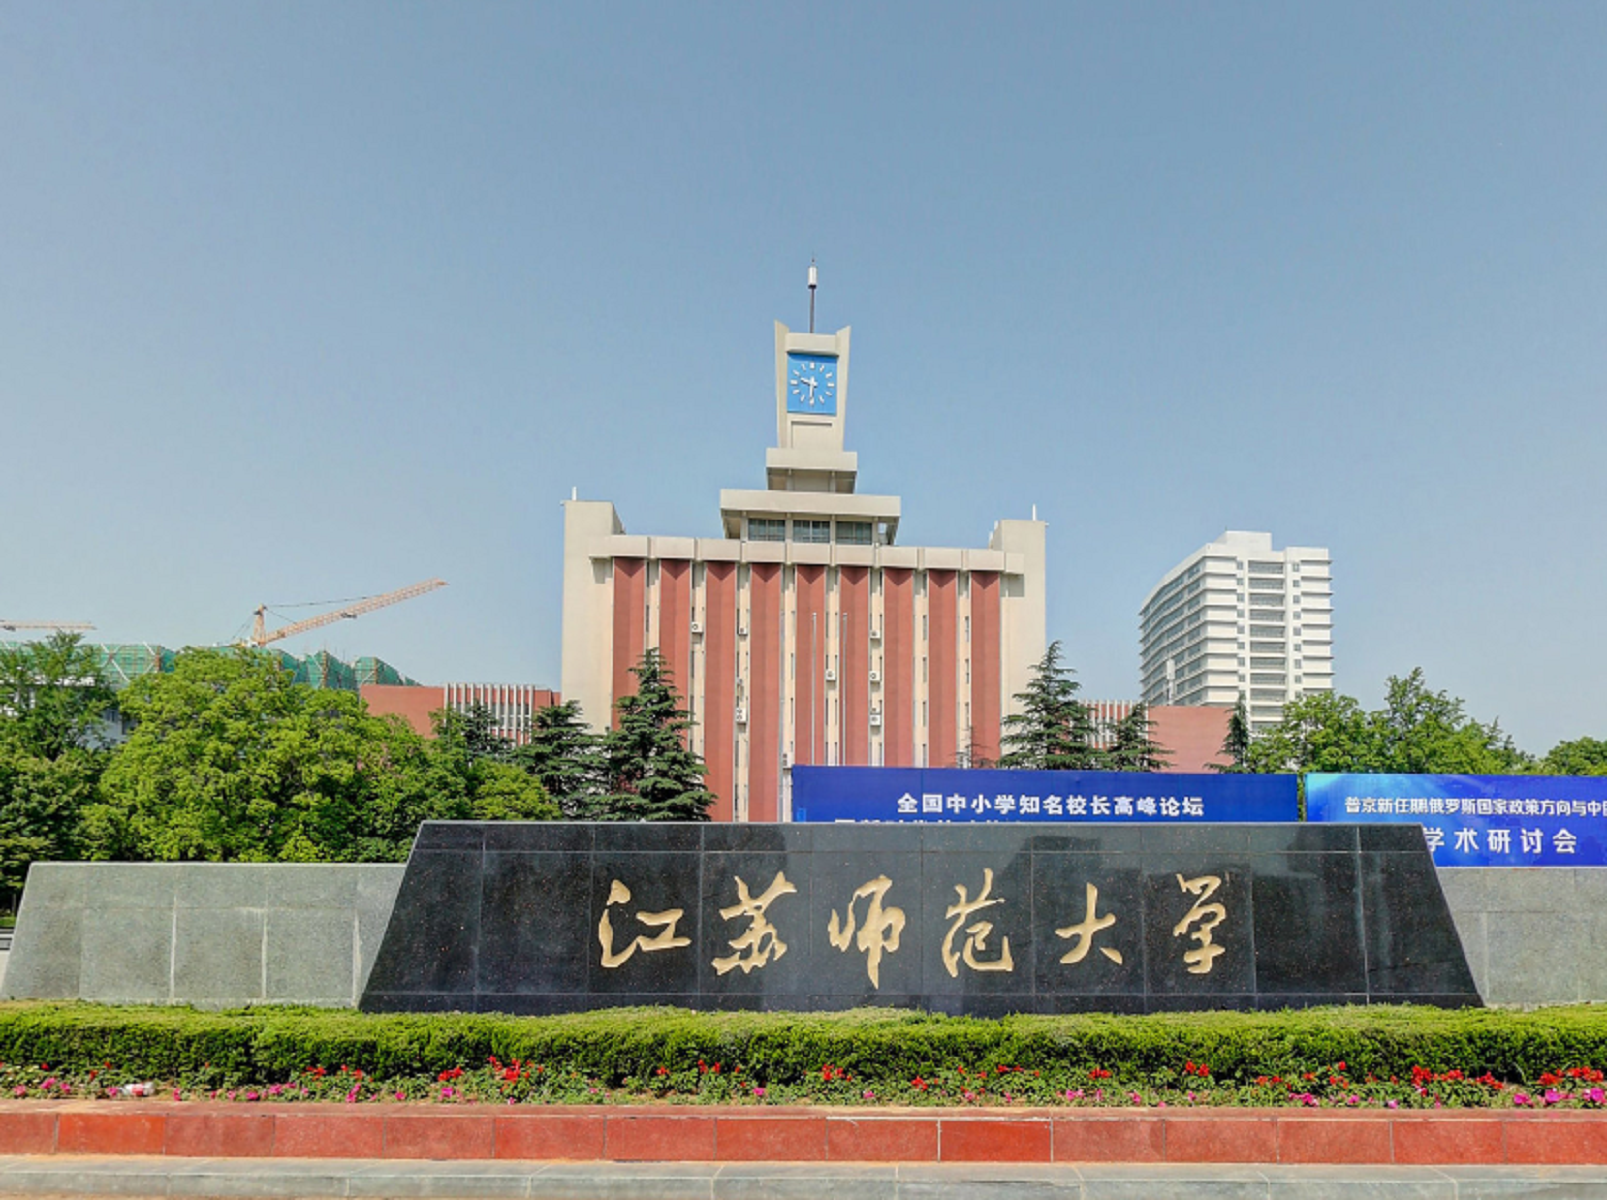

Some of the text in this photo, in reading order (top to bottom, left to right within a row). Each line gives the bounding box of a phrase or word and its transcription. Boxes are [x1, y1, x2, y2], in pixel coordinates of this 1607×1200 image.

[897, 793, 1205, 816] 全国中小学知名校长高峰论坛
[1423, 827, 1577, 854] 学术研讨会
[598, 869, 1226, 988] 江苏师范大学
